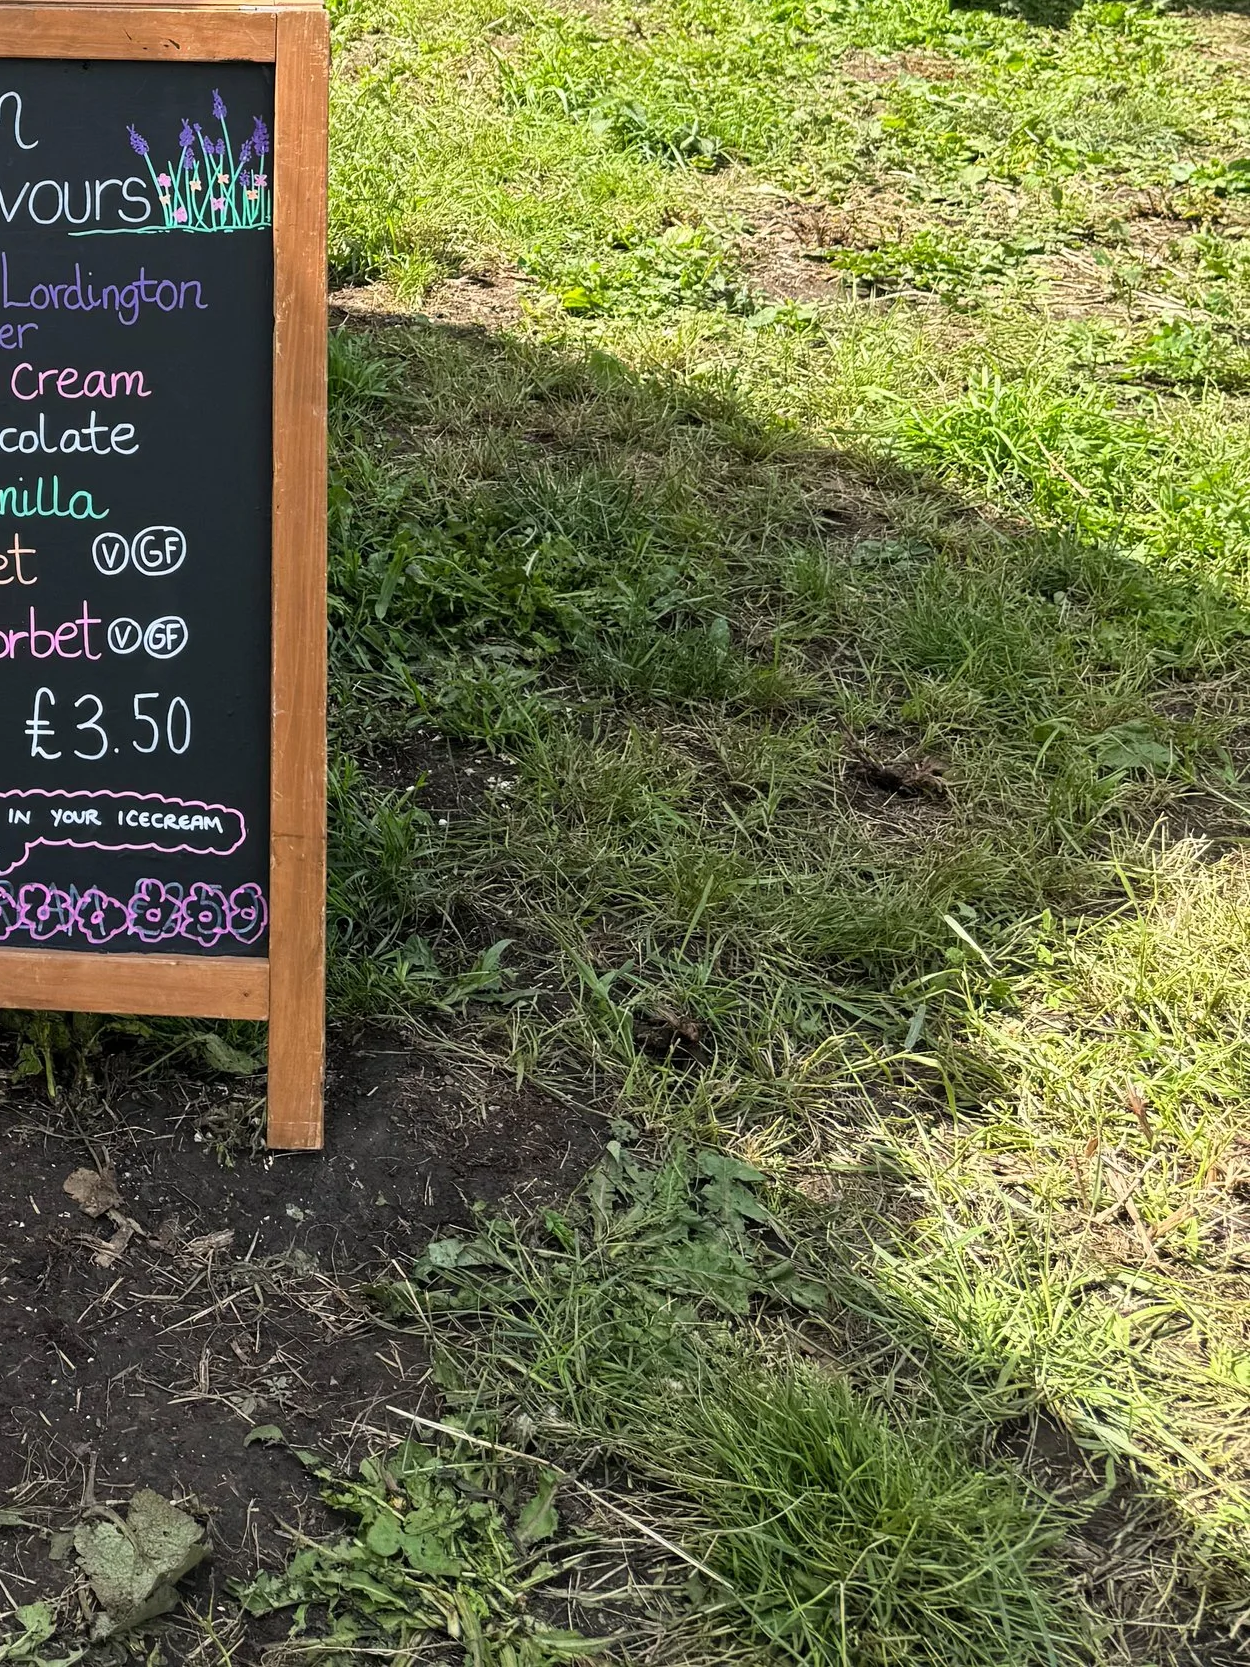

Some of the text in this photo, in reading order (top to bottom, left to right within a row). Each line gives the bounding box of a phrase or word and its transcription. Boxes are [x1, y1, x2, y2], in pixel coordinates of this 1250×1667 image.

[1, 251, 209, 326] Lordington
[10, 362, 152, 401] Cream
[24, 686, 191, 761] £3.50
[8, 807, 32, 825] IN
[50, 808, 103, 828] YOUR
[117, 809, 224, 834] ICECREAM
